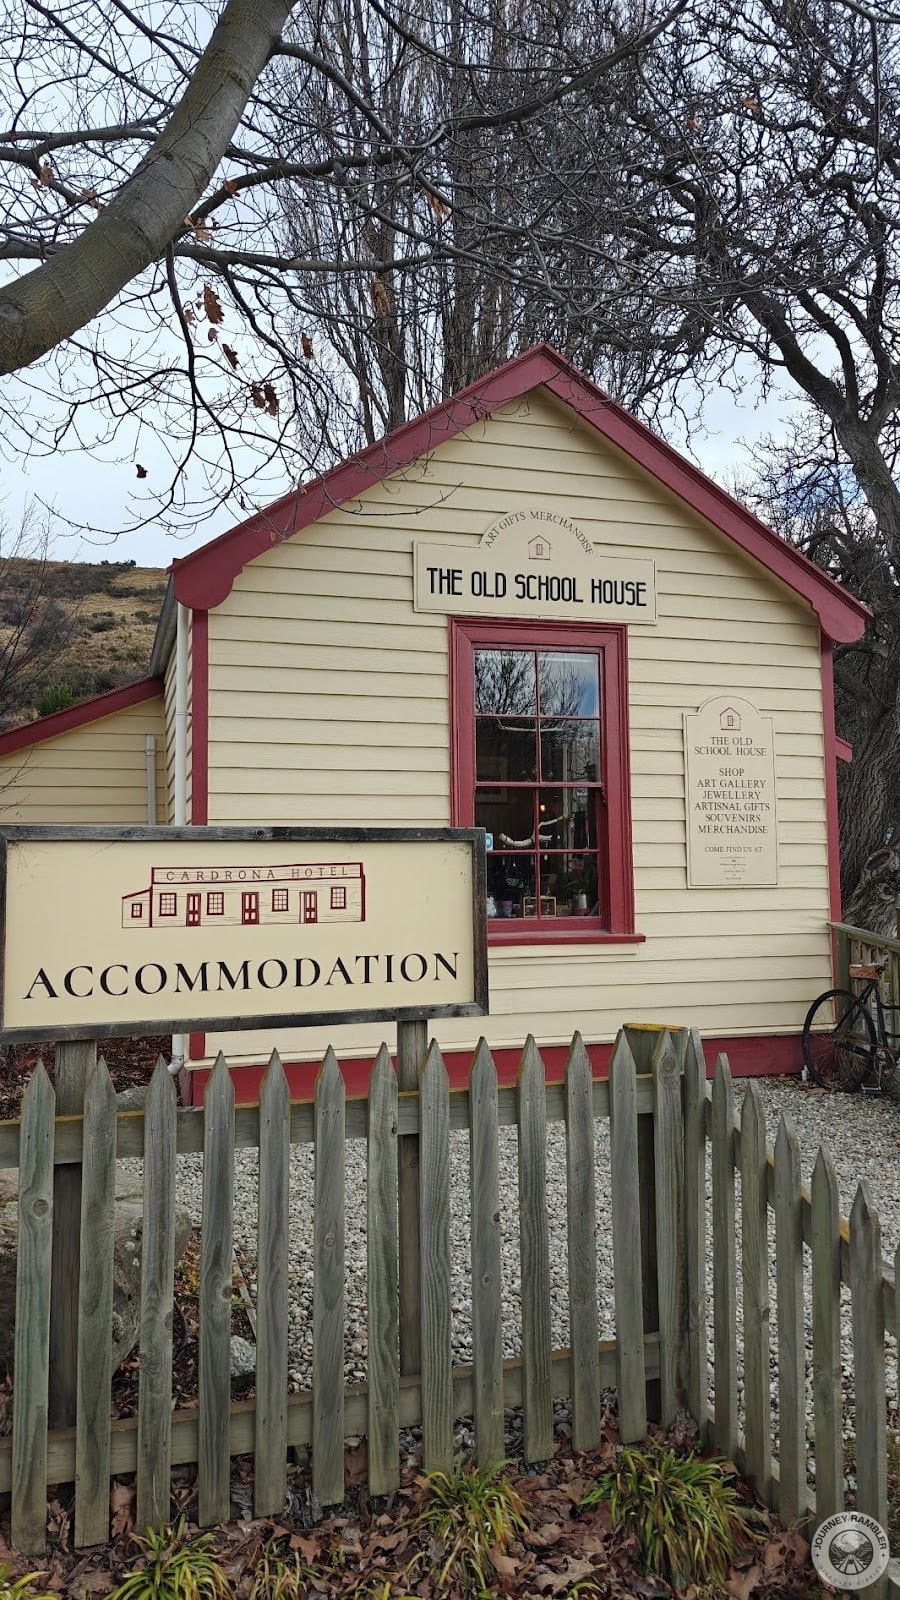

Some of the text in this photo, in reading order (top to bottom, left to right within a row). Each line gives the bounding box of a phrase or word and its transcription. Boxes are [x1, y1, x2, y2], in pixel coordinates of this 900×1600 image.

[485, 511, 593, 555] ART GIFTS MERCHANDISE
[427, 568, 646, 606] THE OLD SCHOOL HOUSE
[710, 737, 753, 746] THE OLD
[695, 747, 766, 756] SCHOOL HOUSE
[719, 768, 744, 777] SHOP
[697, 780, 766, 789] ART GALLERY
[703, 791, 761, 800] JEWELLERY
[744, 803, 770, 811] GIFTS
[706, 814, 760, 822] SOUVENIRS
[698, 825, 768, 834] MERCHANDISE
[166, 866, 348, 882] CARDRONA HOTEL
[22, 952, 458, 1000] ACCOMMODATION
